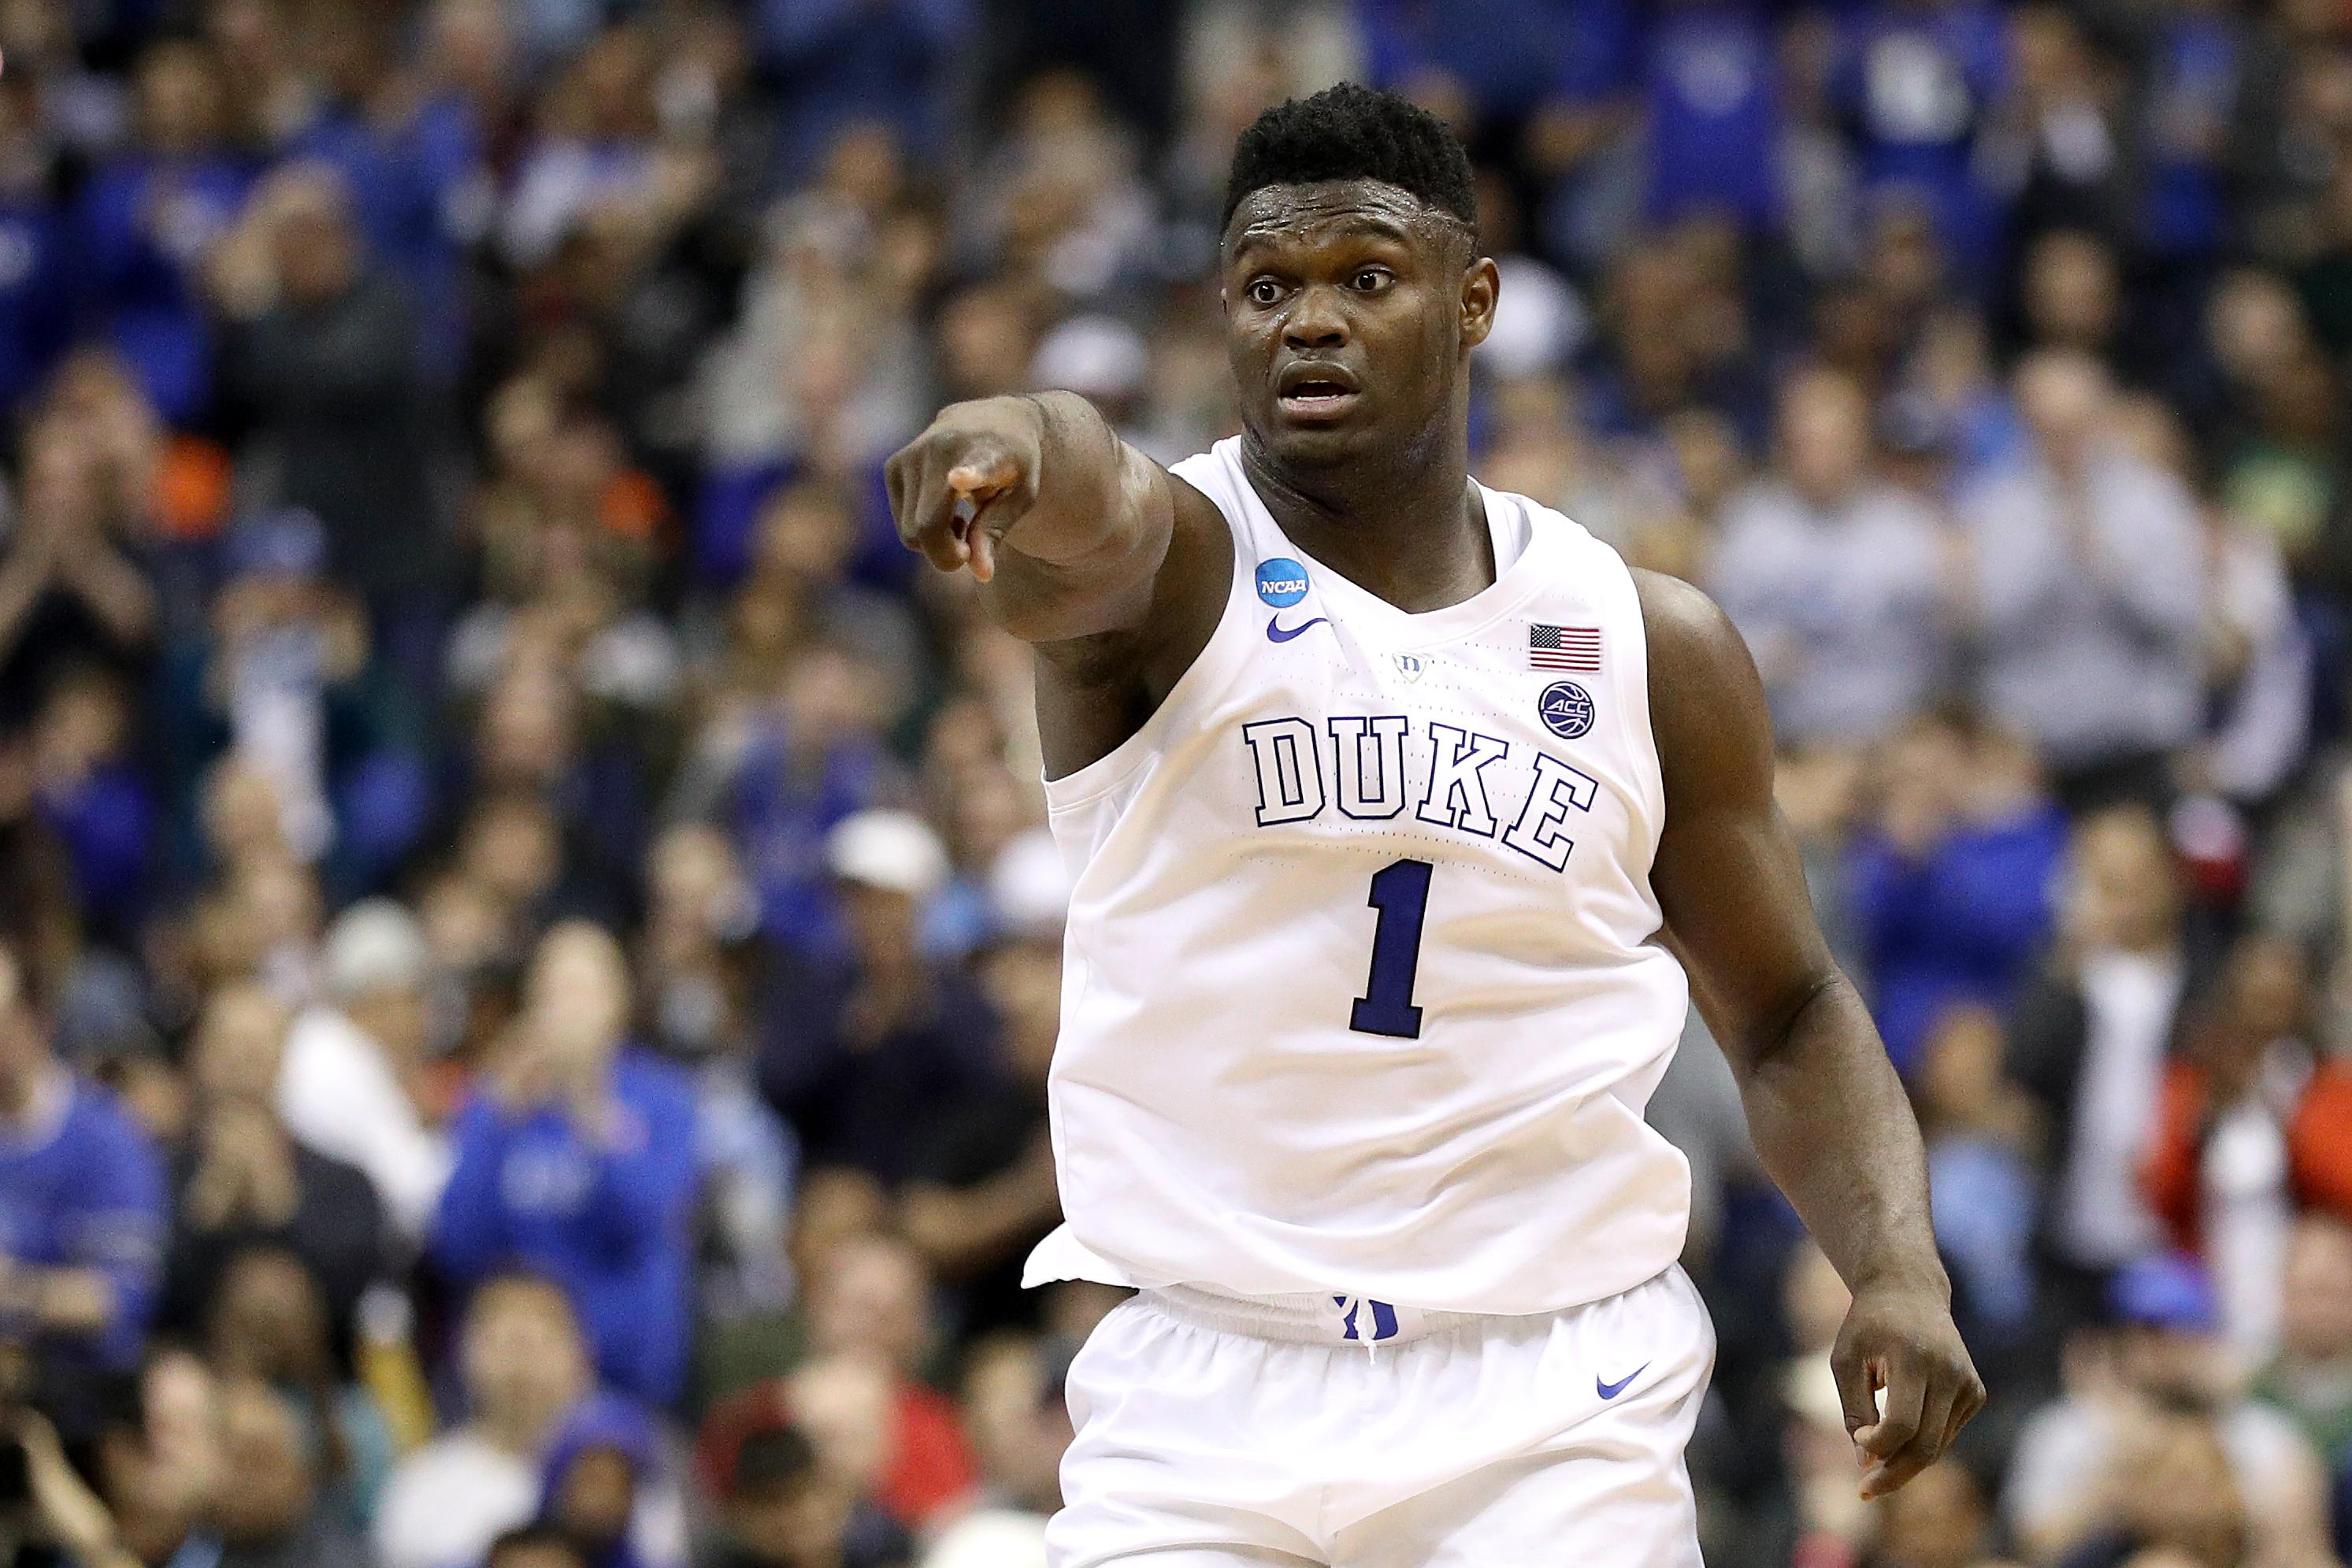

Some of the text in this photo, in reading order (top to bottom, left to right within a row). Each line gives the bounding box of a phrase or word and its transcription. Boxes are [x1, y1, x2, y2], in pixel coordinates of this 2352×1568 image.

[1261, 579, 1307, 594] NCAA
[1547, 699, 1590, 714] ACC
[1242, 715, 1598, 873] DUKE
[1349, 858, 1434, 1040] 1
